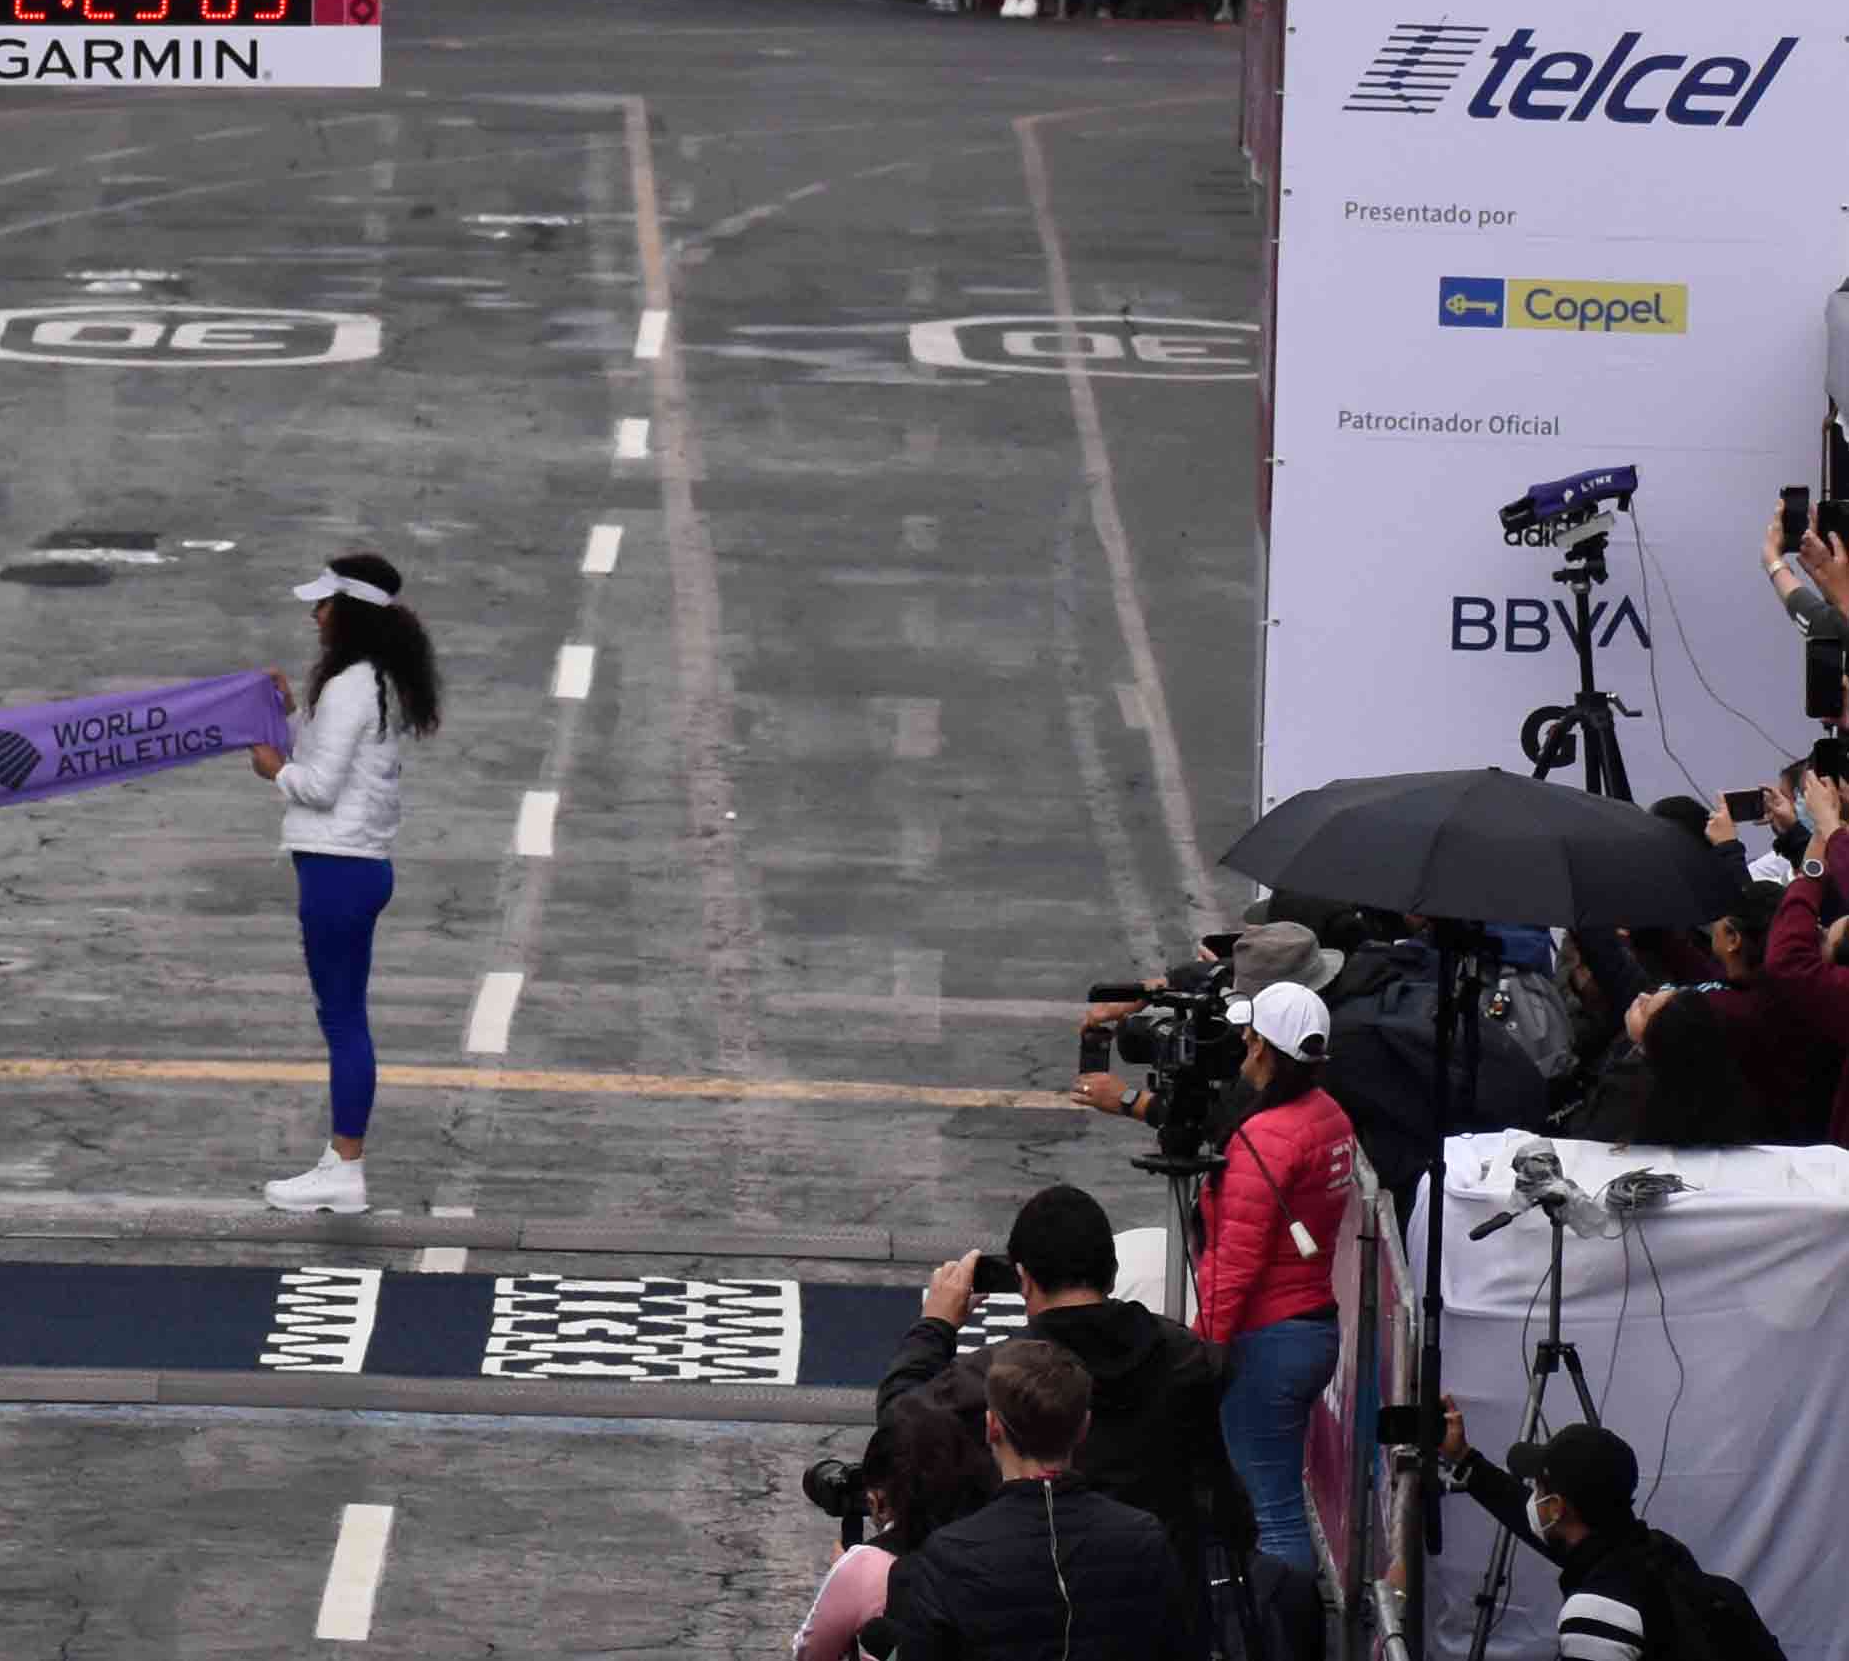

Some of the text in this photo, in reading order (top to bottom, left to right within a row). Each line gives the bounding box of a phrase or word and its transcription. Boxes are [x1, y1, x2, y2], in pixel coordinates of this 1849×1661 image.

[1467, 28, 1800, 127] telcel
[1344, 201, 1517, 229] Presentado por
[1524, 289, 1667, 331] Coppel
[1338, 411, 1561, 437] Patrocinador Oficial
[52, 706, 167, 750] WORLD
[55, 724, 223, 779] ATHLETICS
